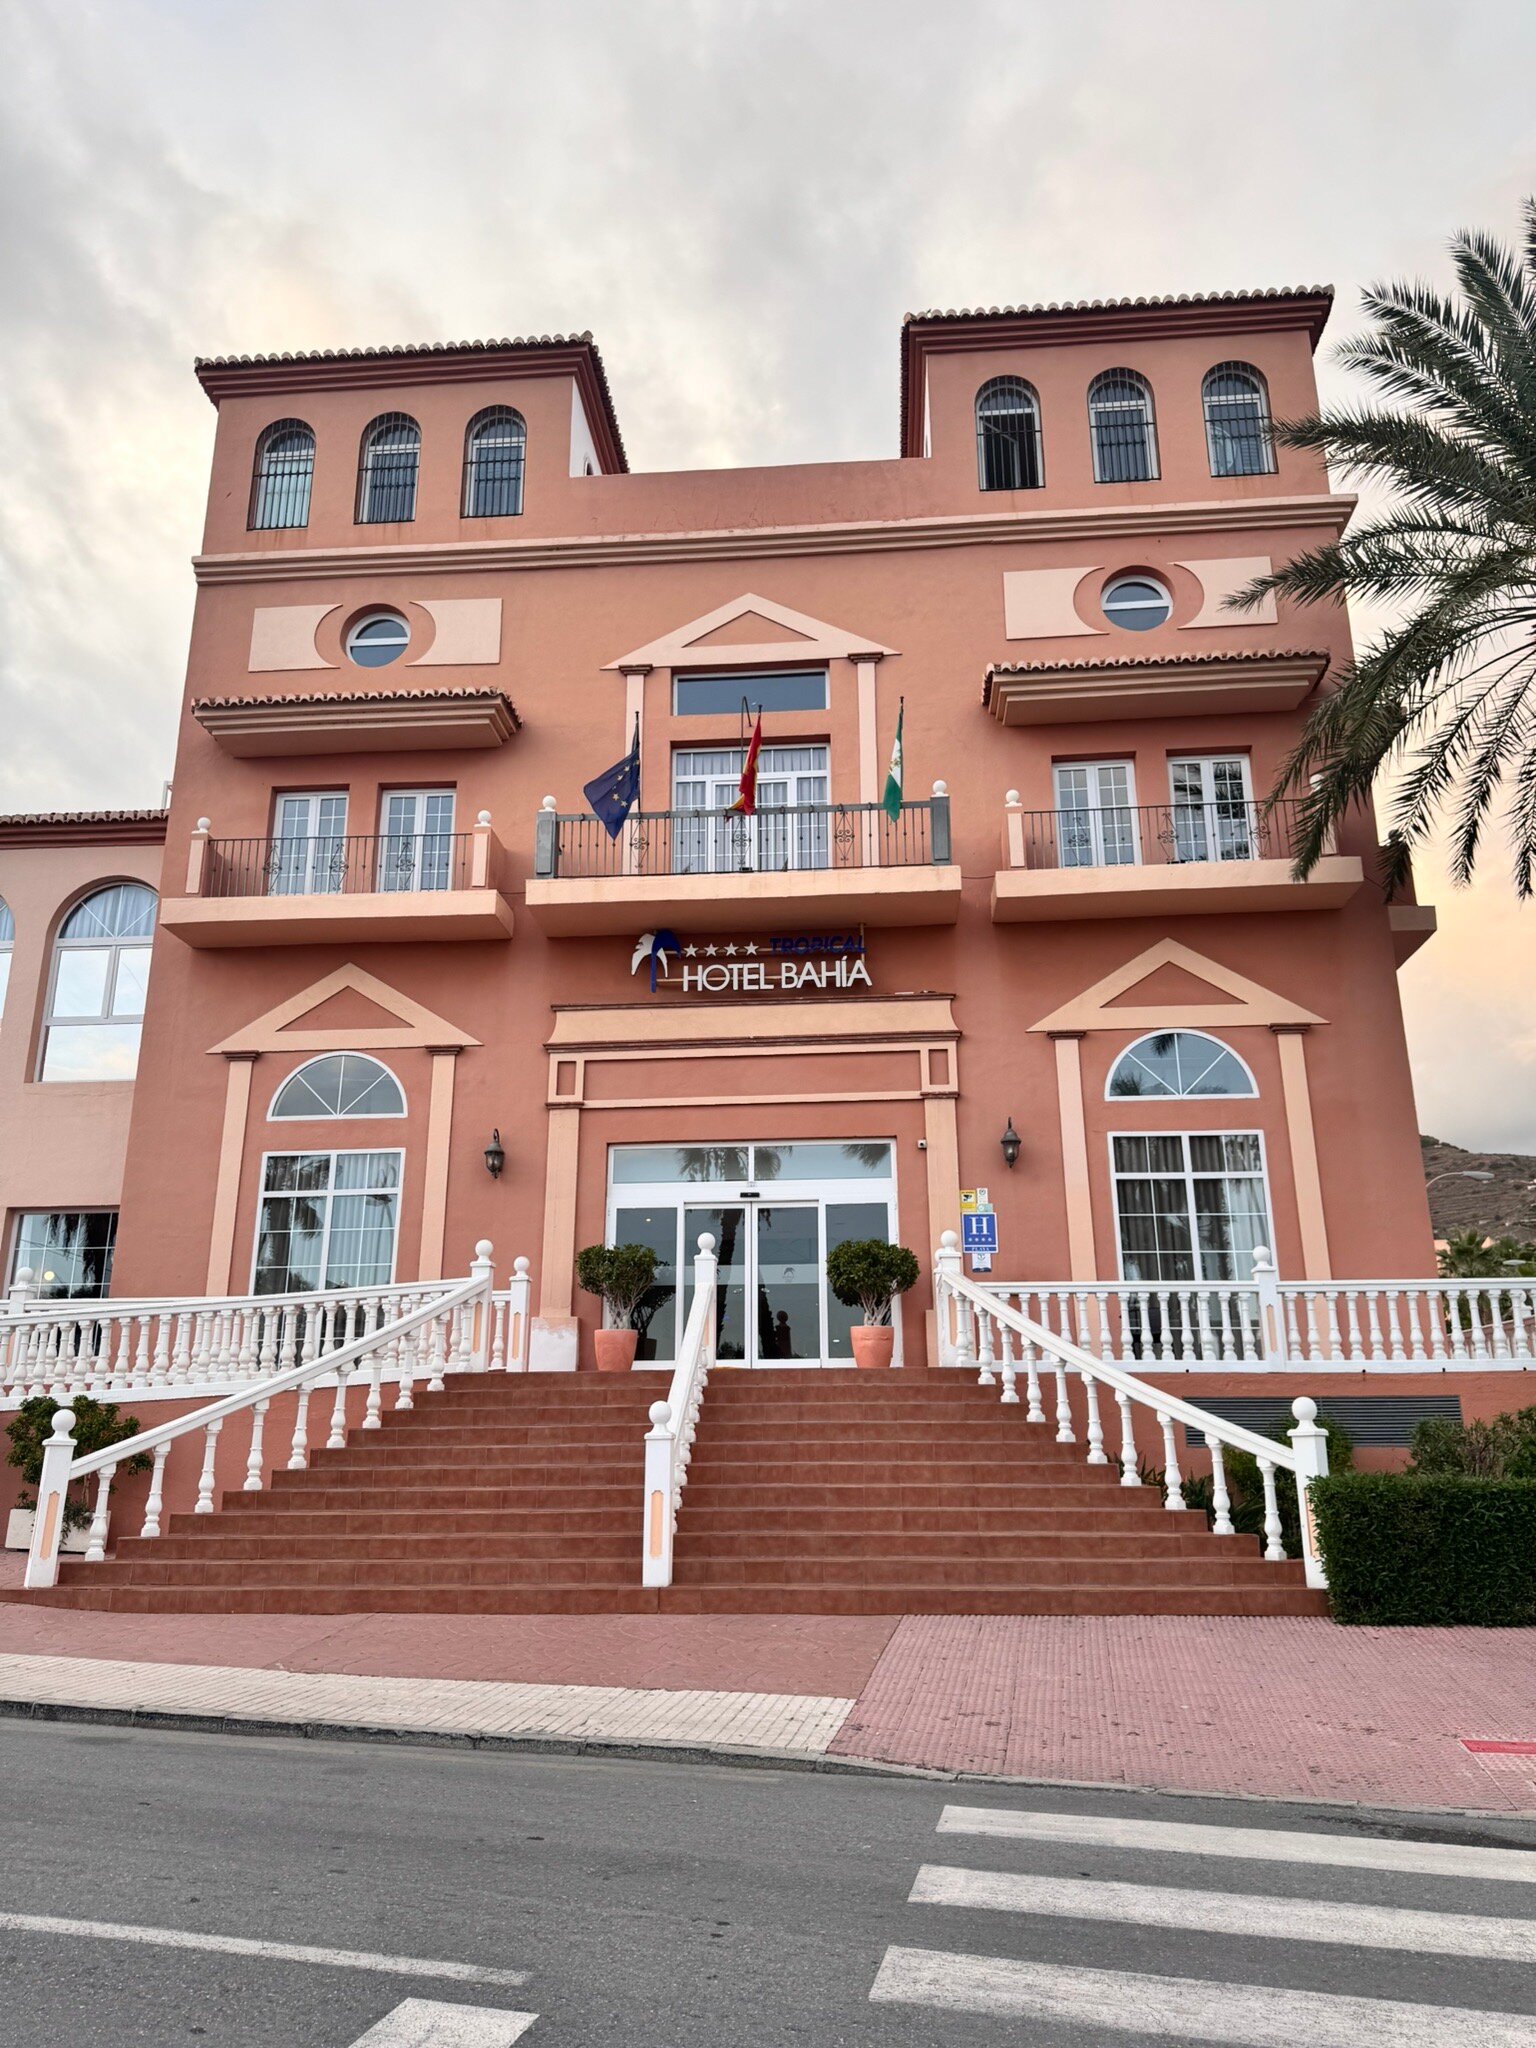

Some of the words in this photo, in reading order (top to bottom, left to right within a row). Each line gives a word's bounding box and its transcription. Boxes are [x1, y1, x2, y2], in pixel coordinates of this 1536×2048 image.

[769, 935, 867, 956] TROPICAL
[682, 962, 774, 992] HOTEL
[781, 956, 873, 989] BAHÍA
[969, 1216, 990, 1235] H
